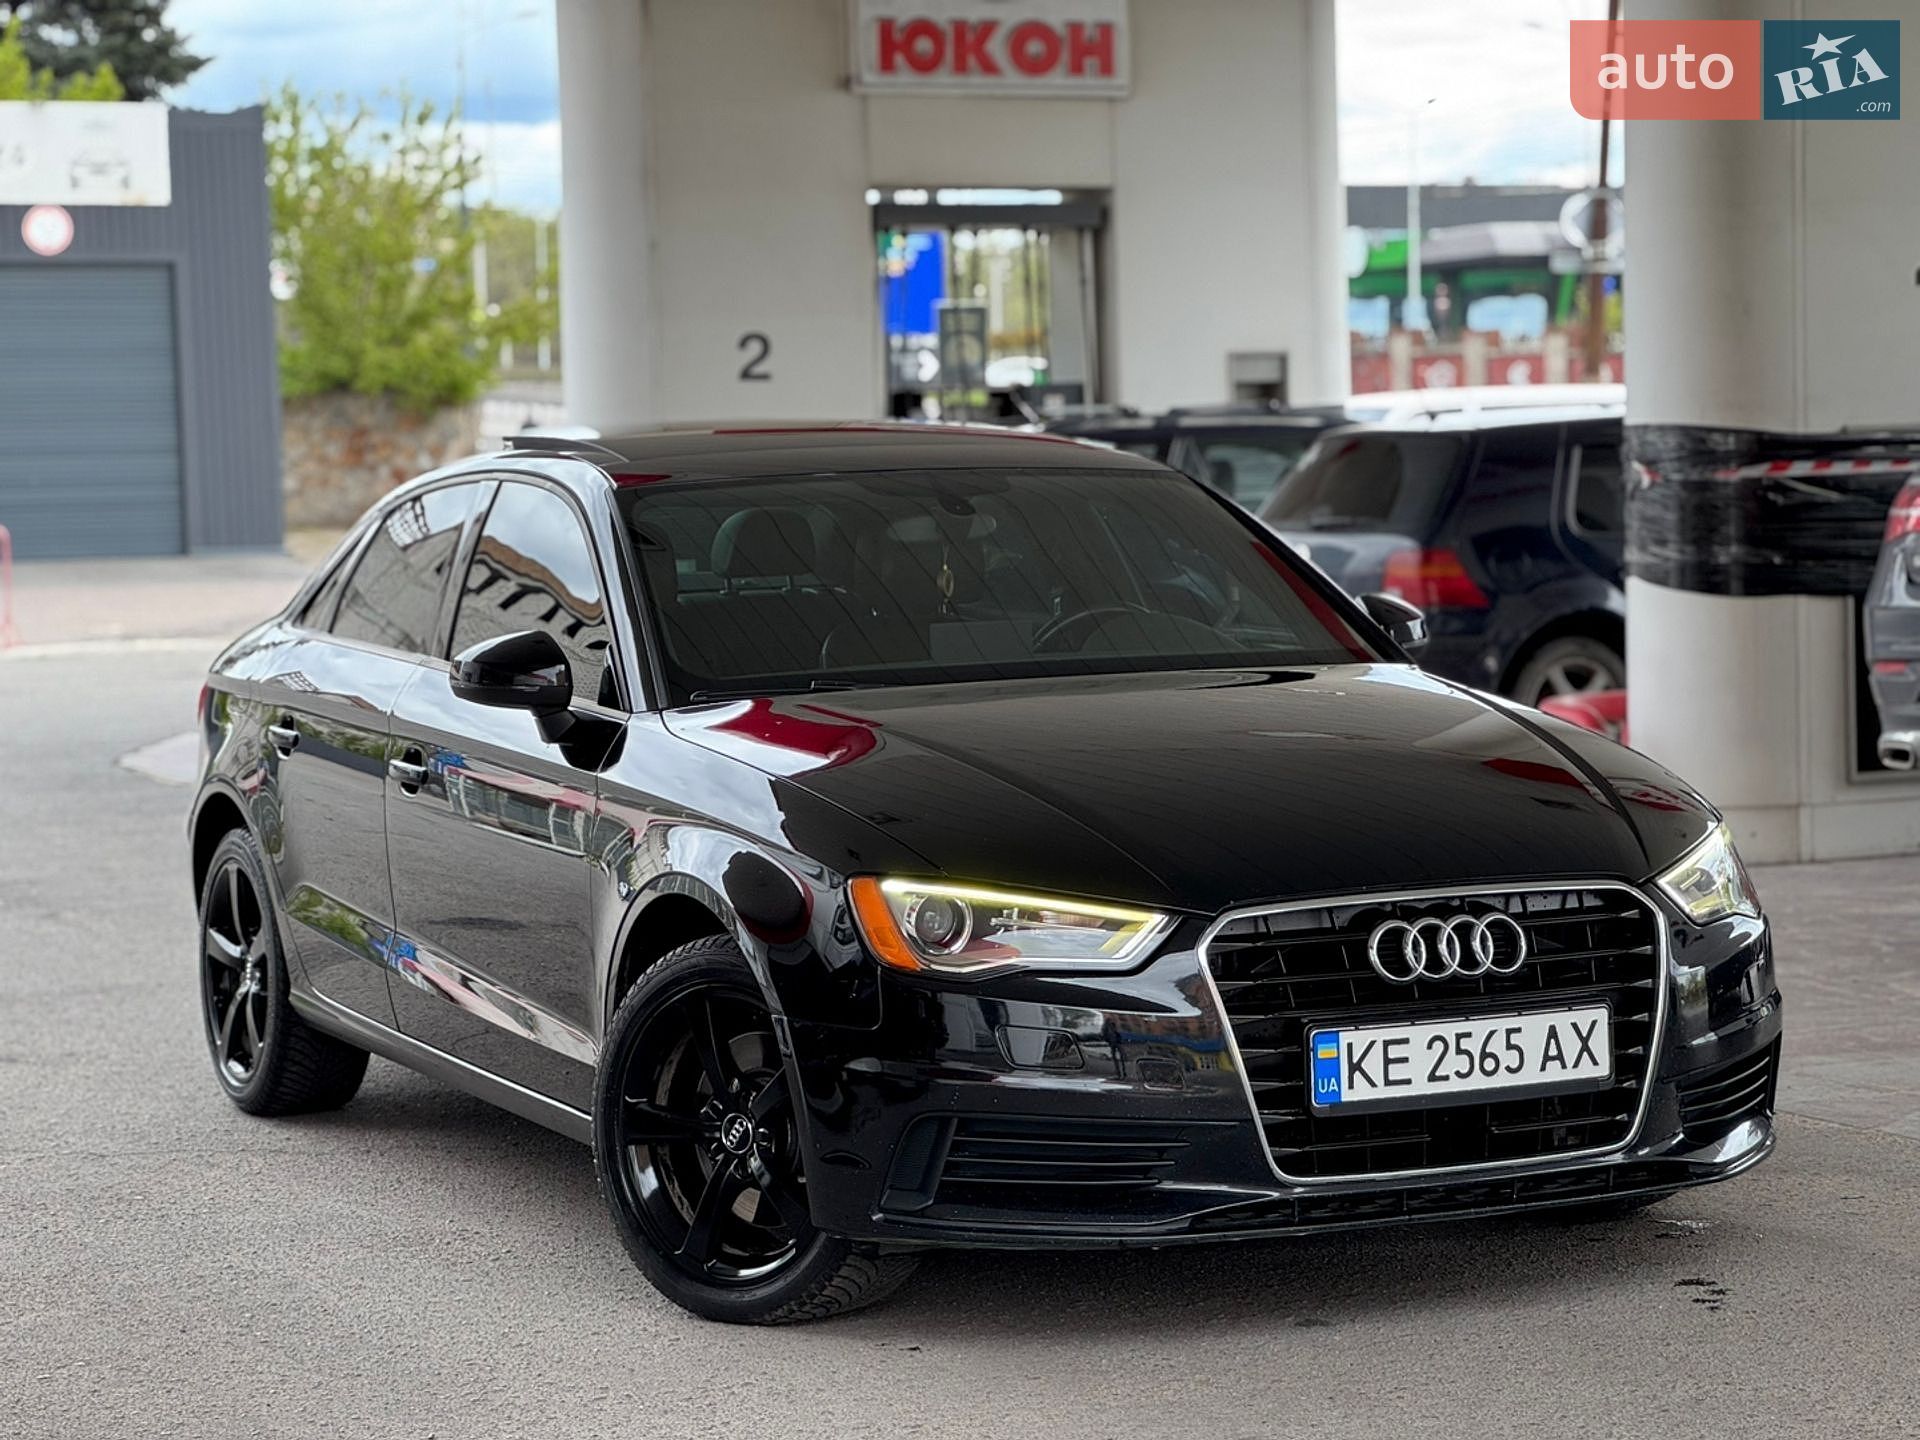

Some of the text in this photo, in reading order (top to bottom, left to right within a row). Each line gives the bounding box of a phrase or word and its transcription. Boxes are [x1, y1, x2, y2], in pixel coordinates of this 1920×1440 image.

[876, 17, 1115, 77] ЮКОН
[738, 331, 771, 382] 2
[1346, 1019, 1600, 1090] KE 2565 AX
[1318, 1076, 1339, 1094] UA
